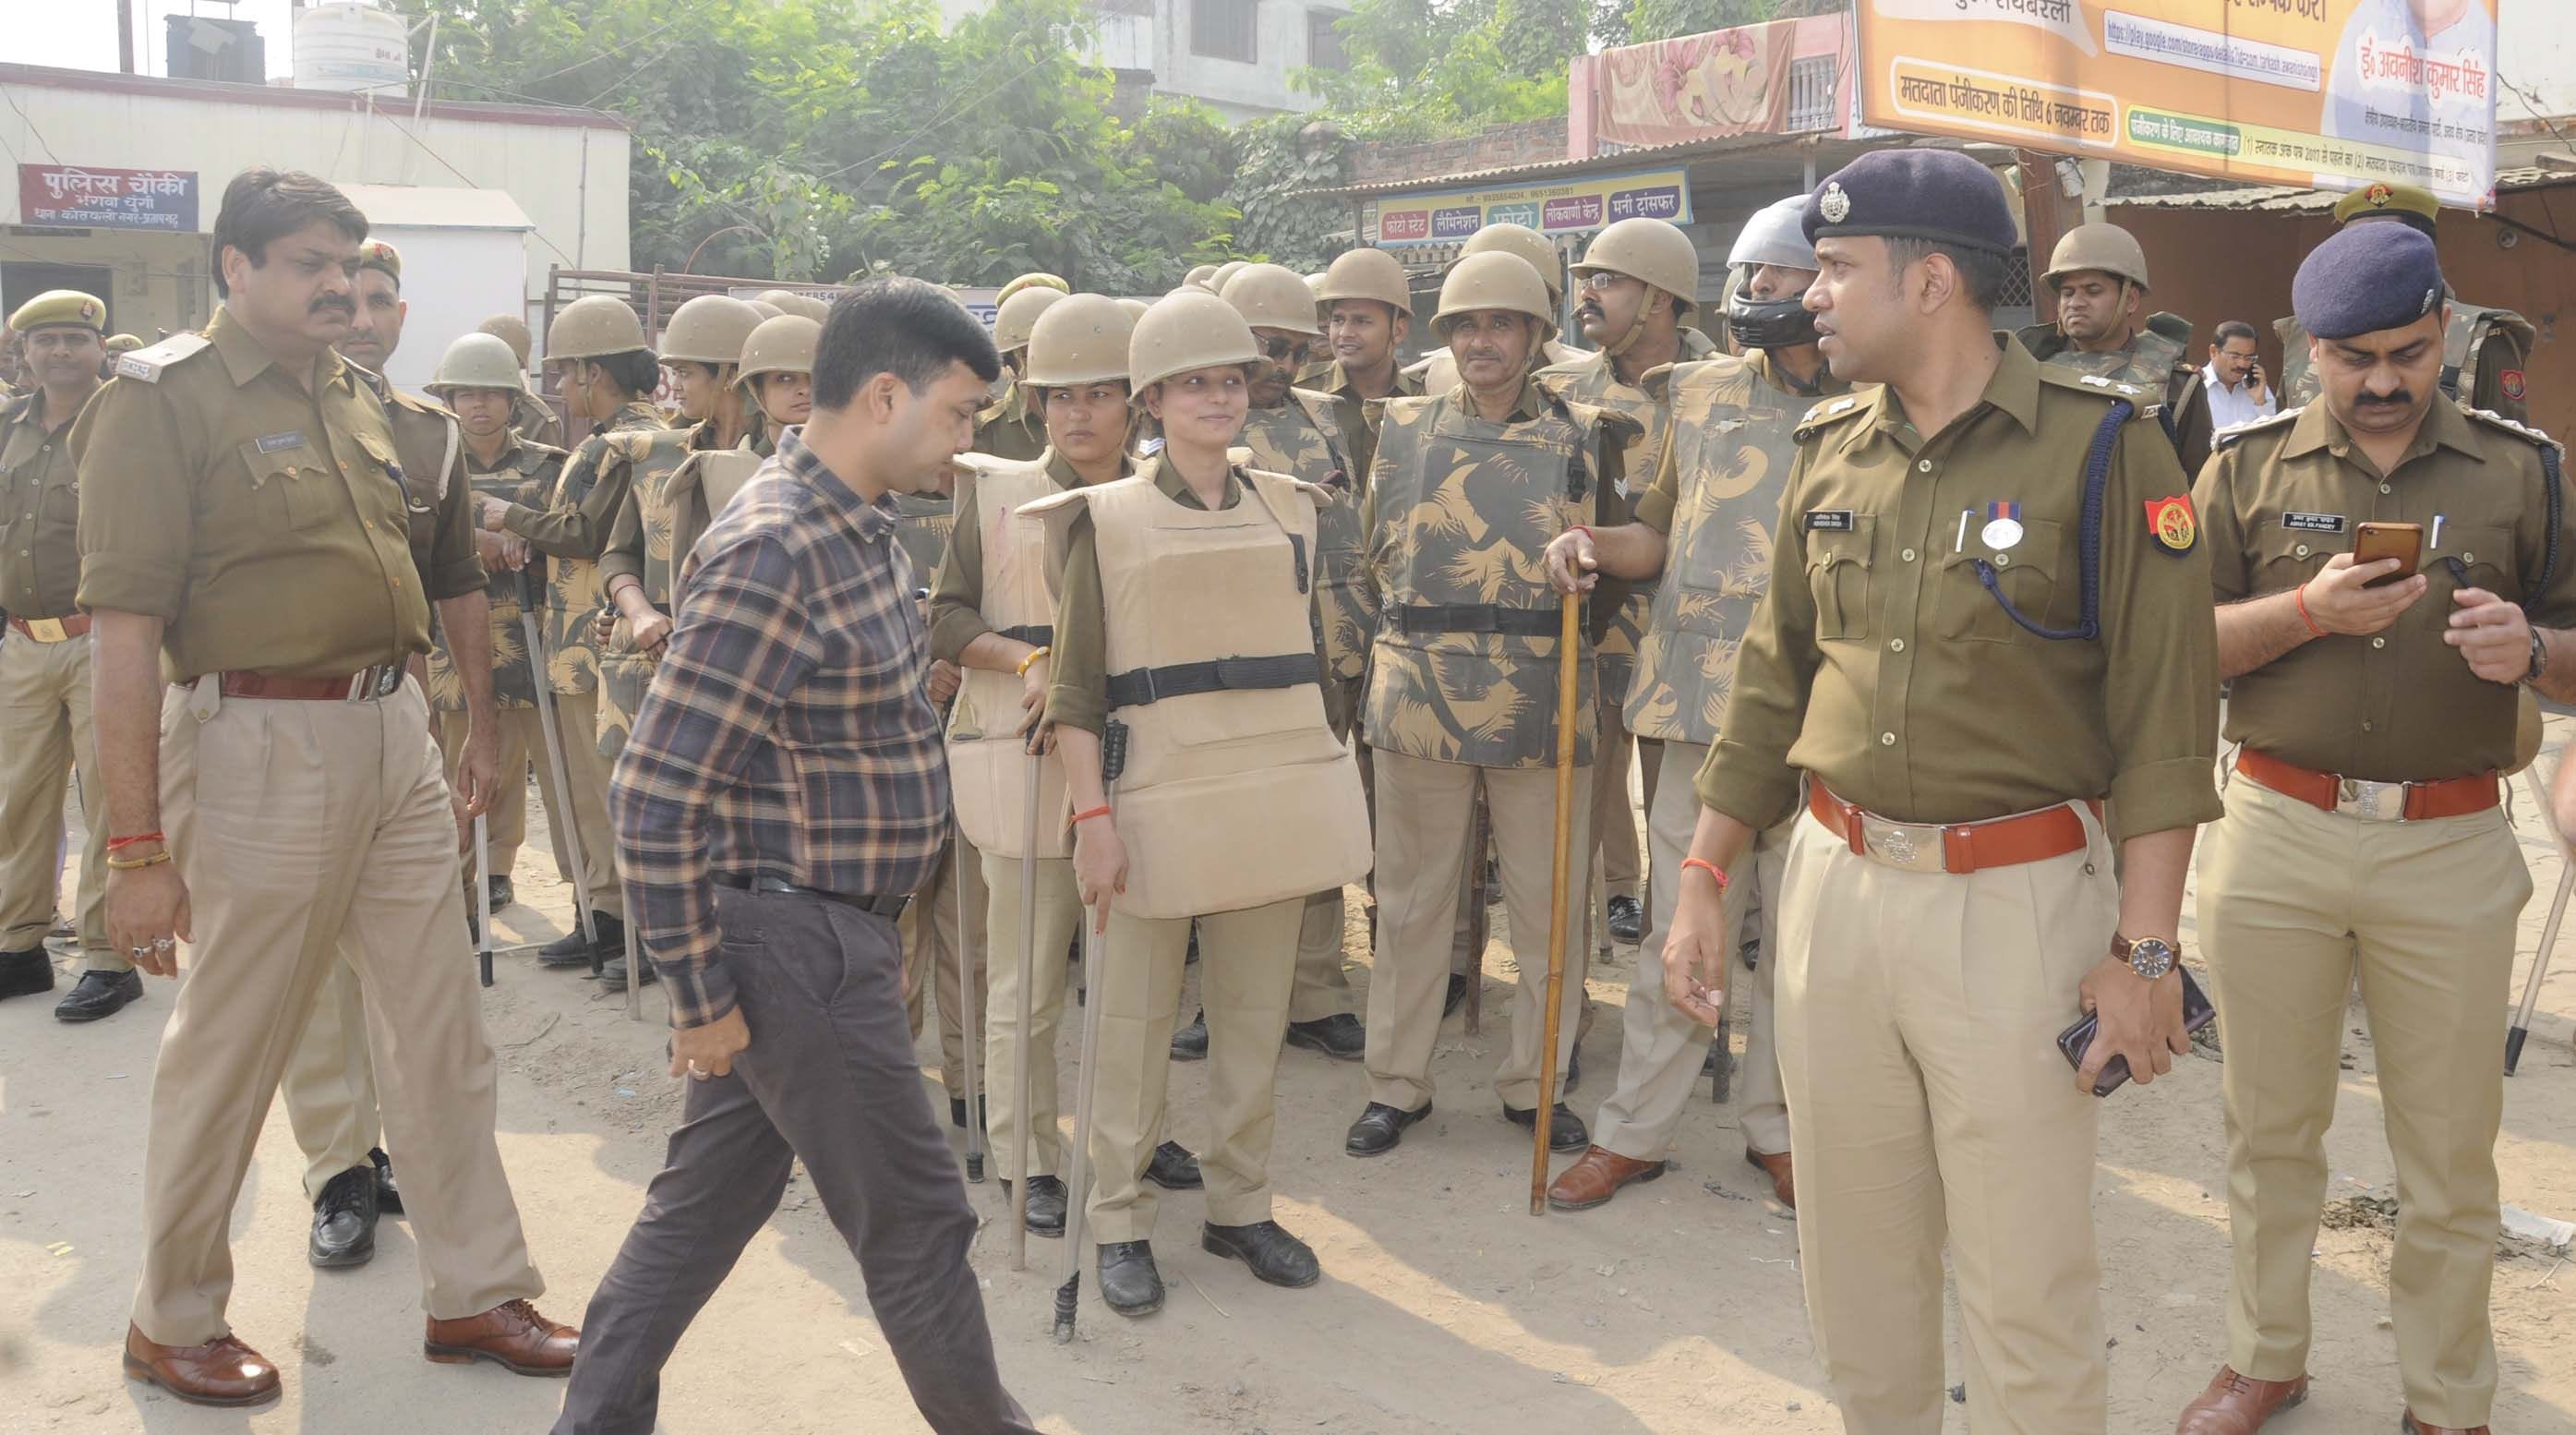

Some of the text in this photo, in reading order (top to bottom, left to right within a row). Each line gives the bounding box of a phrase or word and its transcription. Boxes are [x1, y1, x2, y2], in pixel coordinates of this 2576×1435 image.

[2378, 46, 2424, 85] अवनीश
[2426, 60, 2462, 100] कुमार
[2462, 58, 2486, 98] सिंह
[1900, 76, 2111, 134] मतदाता पंजीकरण की तिथि 6 नवम्बर तक
[42, 168, 187, 199] पुलिस चौकी
[1546, 199, 1600, 223] लोकवाणी केन्द्र
[1612, 192, 1675, 217] मनी ट्रांसफर
[1386, 214, 1426, 235] फोटो स्टेट
